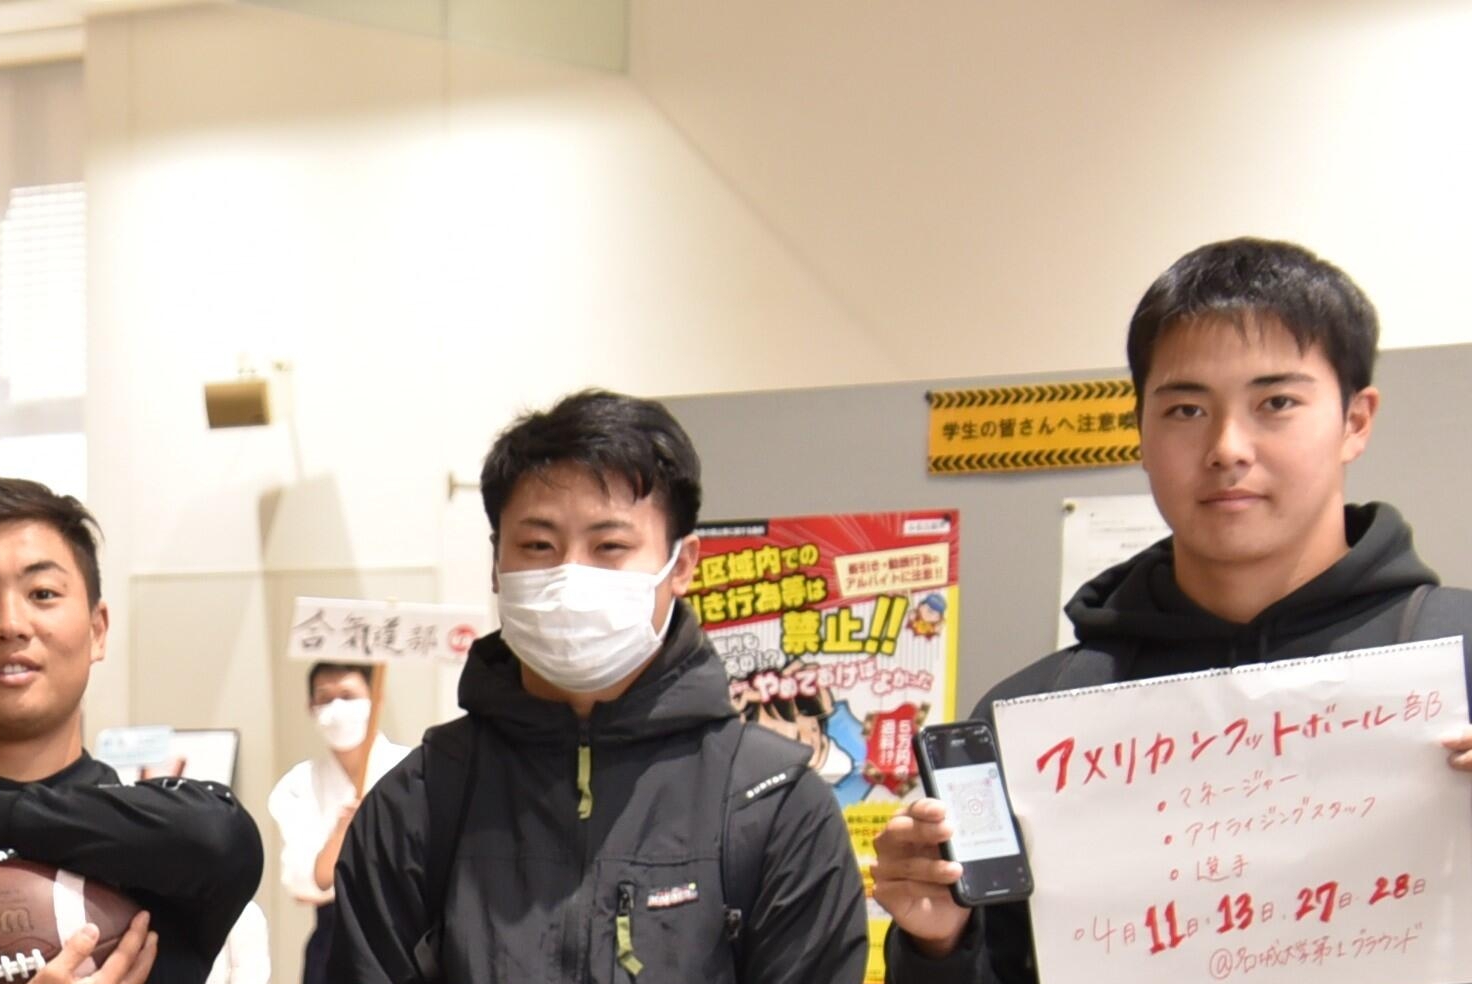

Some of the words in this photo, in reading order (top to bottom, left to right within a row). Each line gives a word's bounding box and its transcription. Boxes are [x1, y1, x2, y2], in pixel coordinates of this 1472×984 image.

[686, 574, 827, 626] き行為等は
[1036, 689, 1443, 793] アメリカンフットボール部
[1179, 770, 1299, 808] マネージャー
[1195, 855, 1250, 882] 選手
